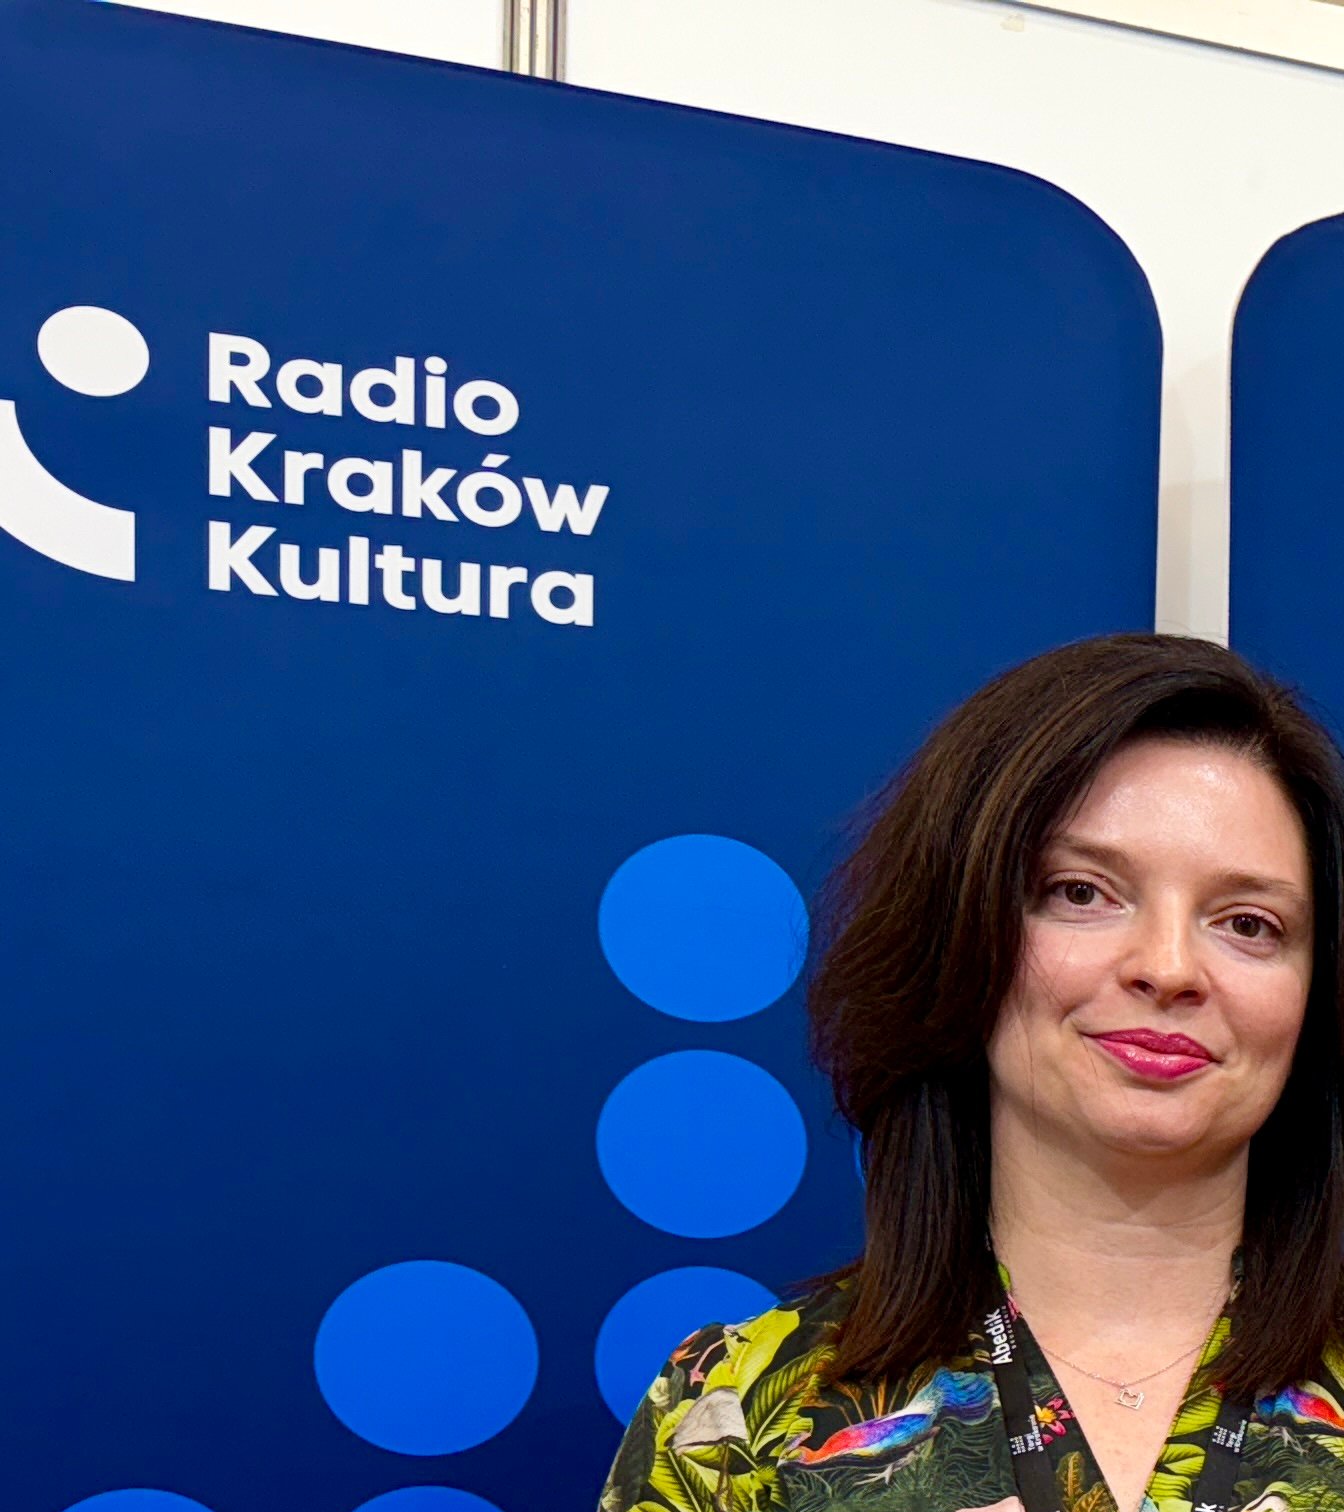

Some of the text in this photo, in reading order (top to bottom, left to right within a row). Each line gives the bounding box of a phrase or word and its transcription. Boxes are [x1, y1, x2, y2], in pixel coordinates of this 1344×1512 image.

[208, 331, 520, 437] Radio
[208, 425, 610, 536] Kraków
[207, 520, 594, 627] Kultura
[984, 1307, 1013, 1365] Abedik
